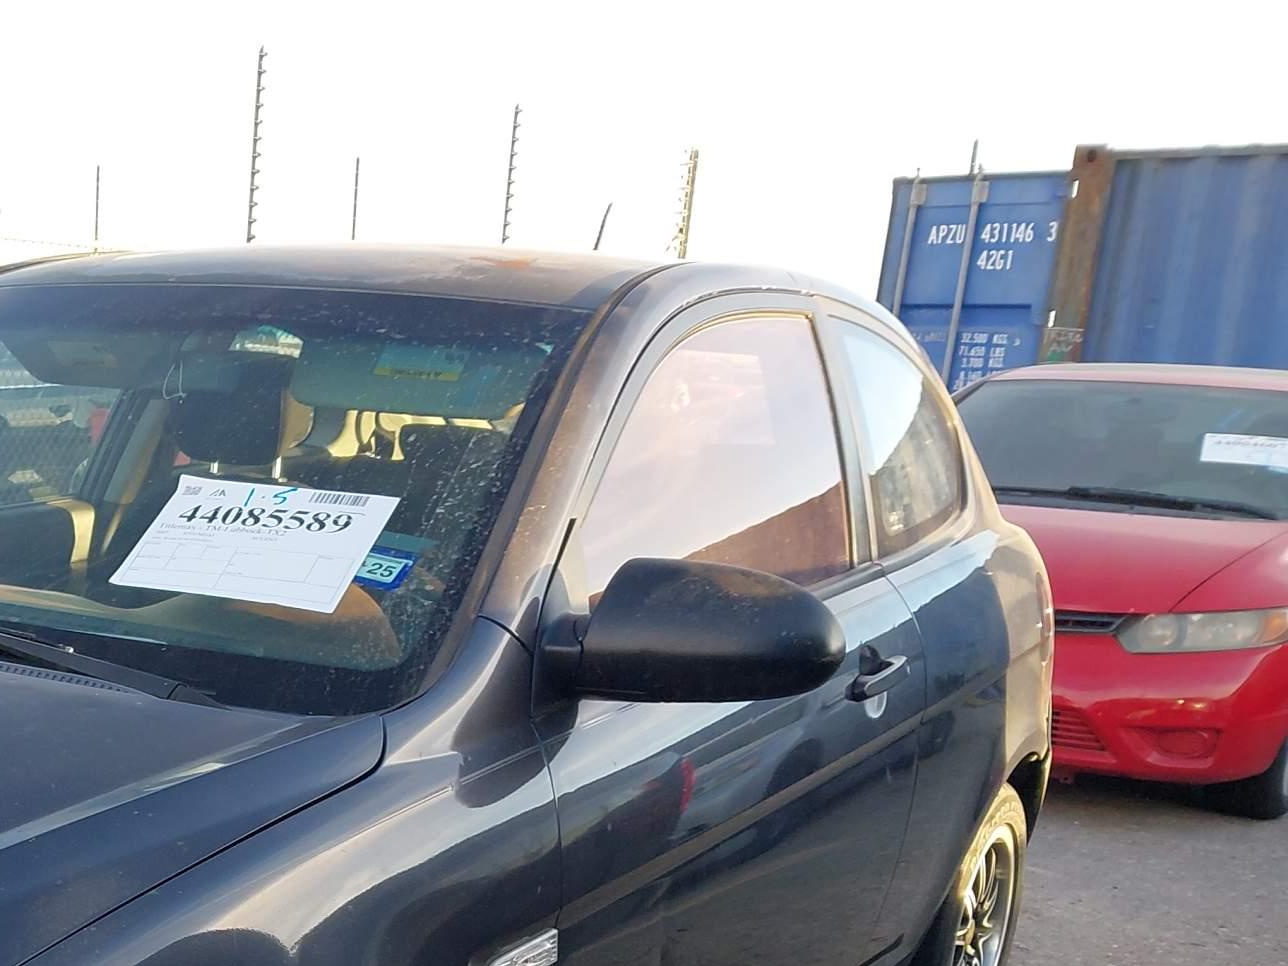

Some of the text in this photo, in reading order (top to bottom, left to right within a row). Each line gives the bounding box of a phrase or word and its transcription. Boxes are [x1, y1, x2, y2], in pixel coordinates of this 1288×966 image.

[927, 221, 1059, 244] APZU 431146 3
[976, 249, 1014, 270] 42G1
[178, 504, 353, 534] 44085589
[365, 562, 397, 578] 25
